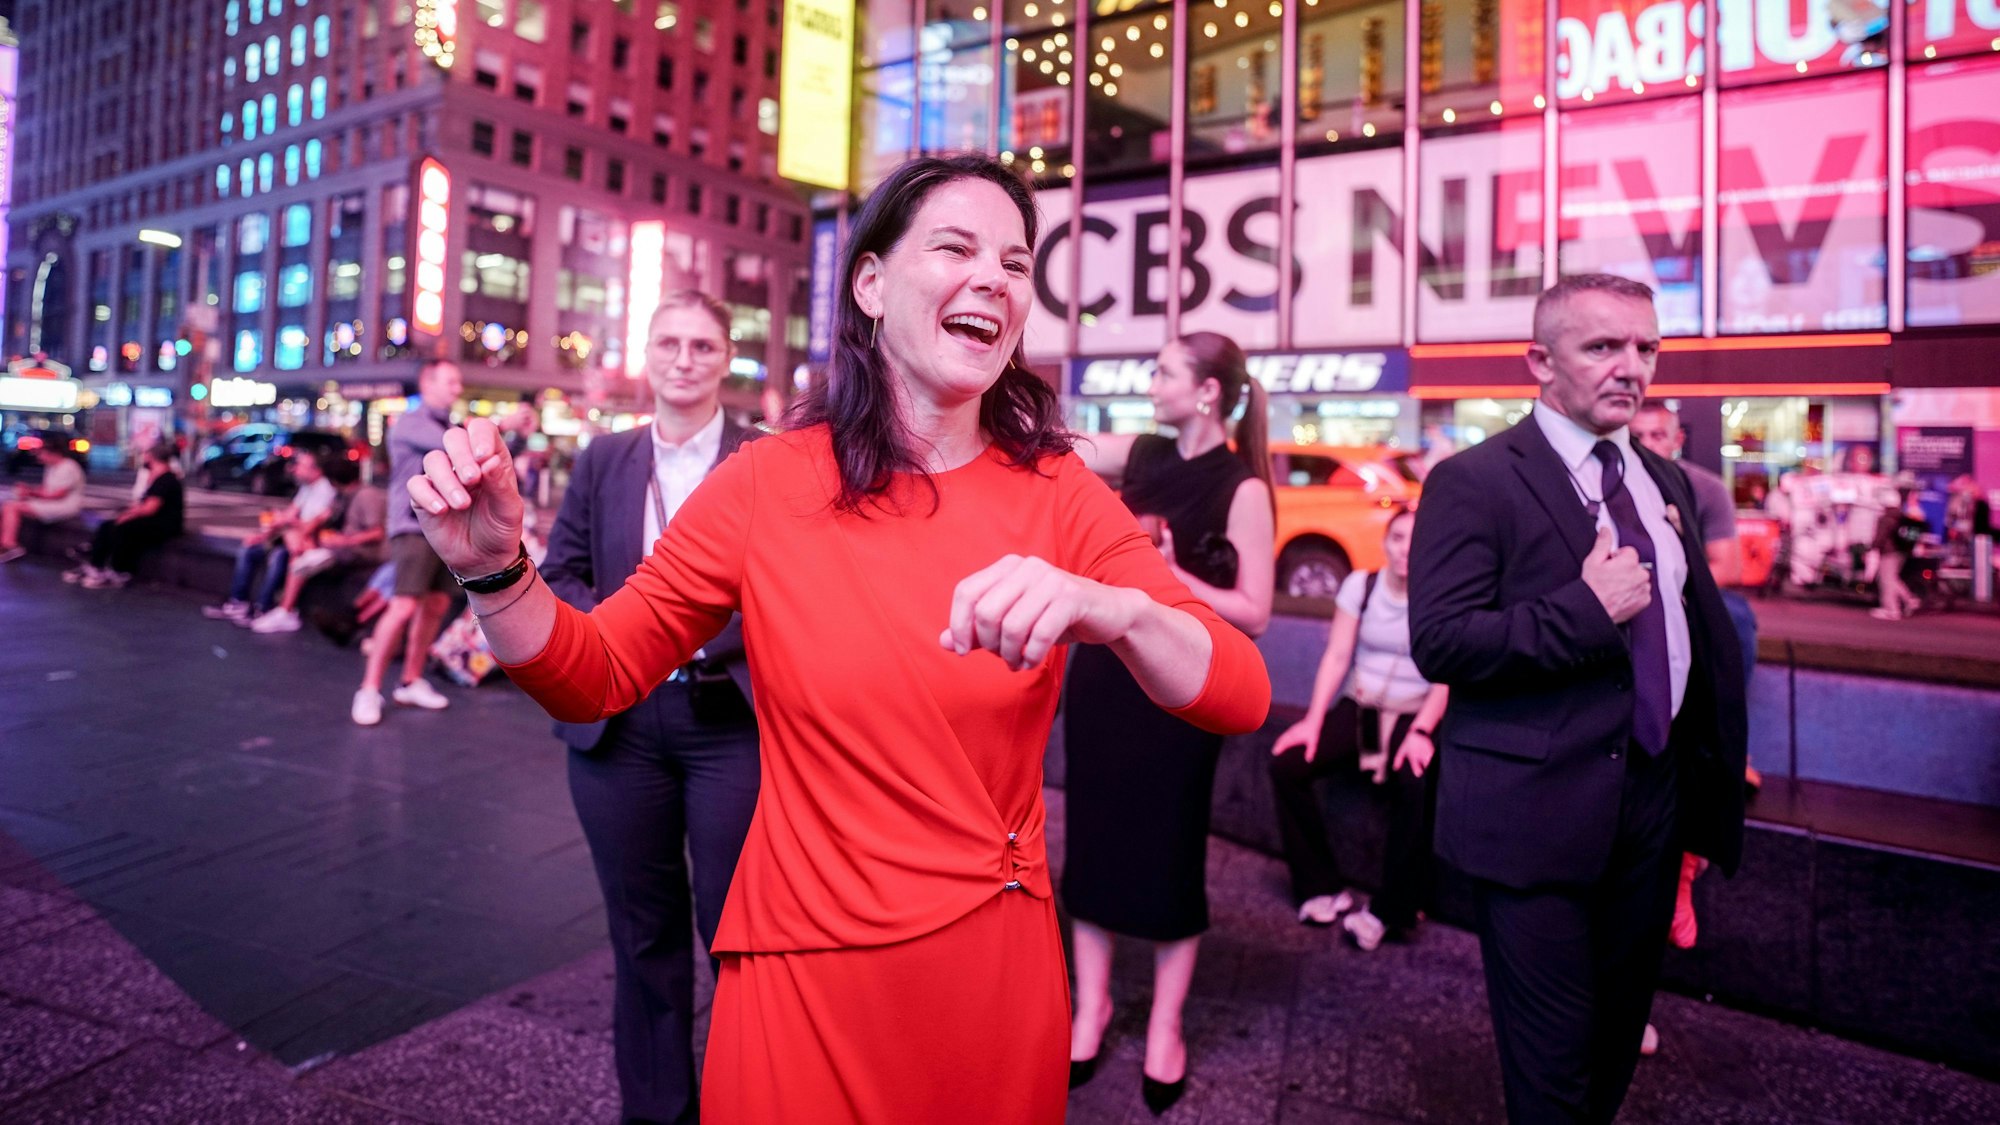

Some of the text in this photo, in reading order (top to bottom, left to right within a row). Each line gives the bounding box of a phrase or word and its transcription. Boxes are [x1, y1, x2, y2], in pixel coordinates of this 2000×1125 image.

[1034, 117, 2000, 320] CBS NEWS
[1079, 352, 1387, 395] SKERS
